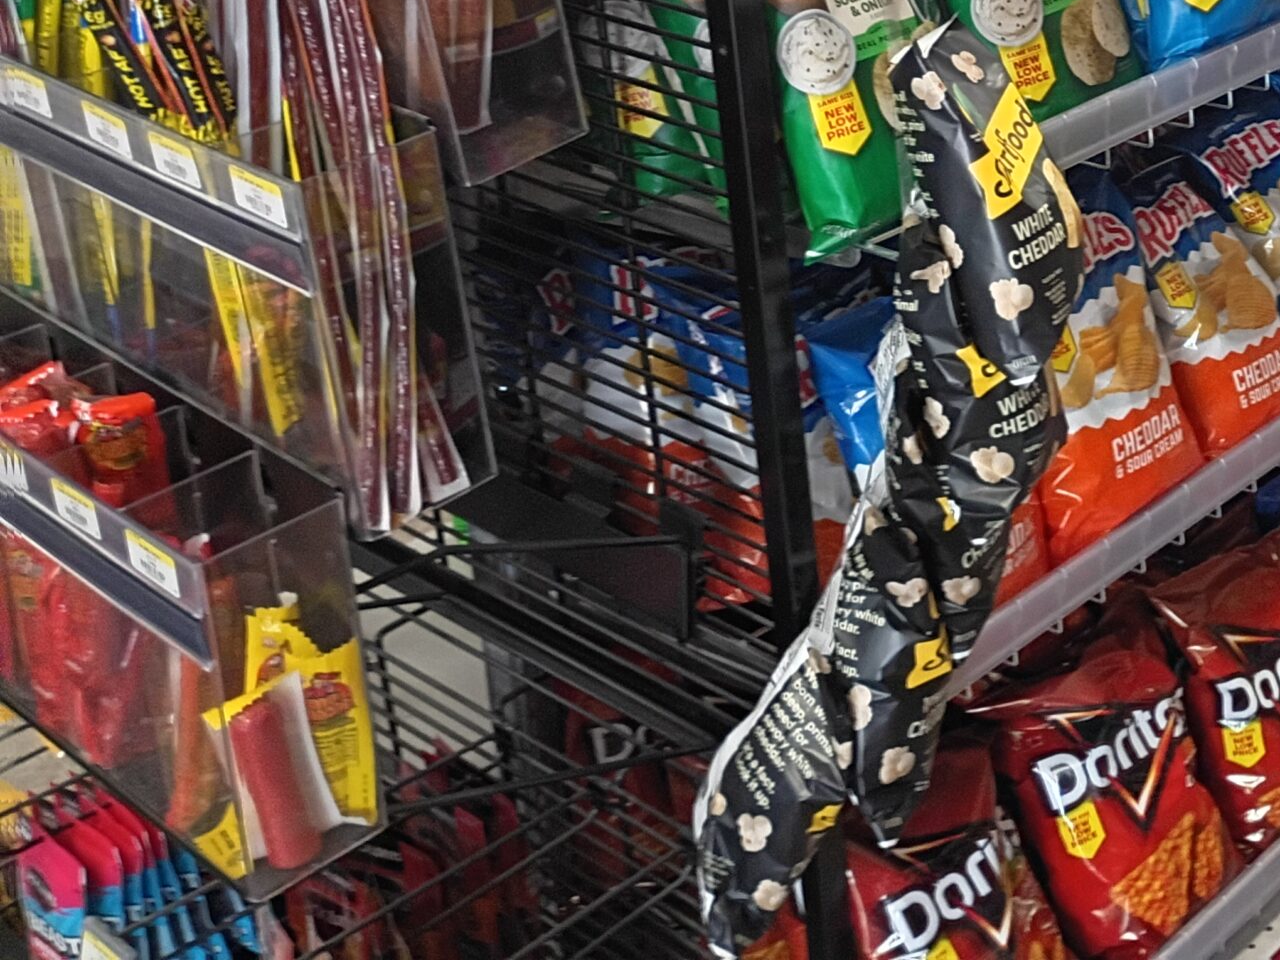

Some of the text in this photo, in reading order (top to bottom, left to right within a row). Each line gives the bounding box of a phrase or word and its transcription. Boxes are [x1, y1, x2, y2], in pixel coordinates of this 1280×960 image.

[850, 5, 861, 17] &
[1013, 53, 1040, 71] NEW
[1016, 64, 1042, 81] LOW
[120, 74, 154, 109] HOT
[183, 75, 208, 113] HOT
[1015, 72, 1050, 90] PRICE
[824, 102, 855, 120] NEW
[828, 112, 858, 130] LOW
[826, 121, 866, 142] PRICE
[1011, 203, 1054, 242] WHITE
[1007, 222, 1066, 271] CHEDDAR
[1238, 394, 1248, 409] &
[1248, 382, 1271, 404] SOUR
[1112, 404, 1181, 462] CHEDDAR
[1115, 428, 1184, 479] & SOUR CREAM
[845, 593, 867, 604] for
[855, 607, 886, 628] white
[792, 680, 816, 708] born
[782, 692, 806, 724] deep,
[771, 702, 810, 747] need for
[762, 714, 813, 779] savory white
[753, 789, 772, 810] up.
